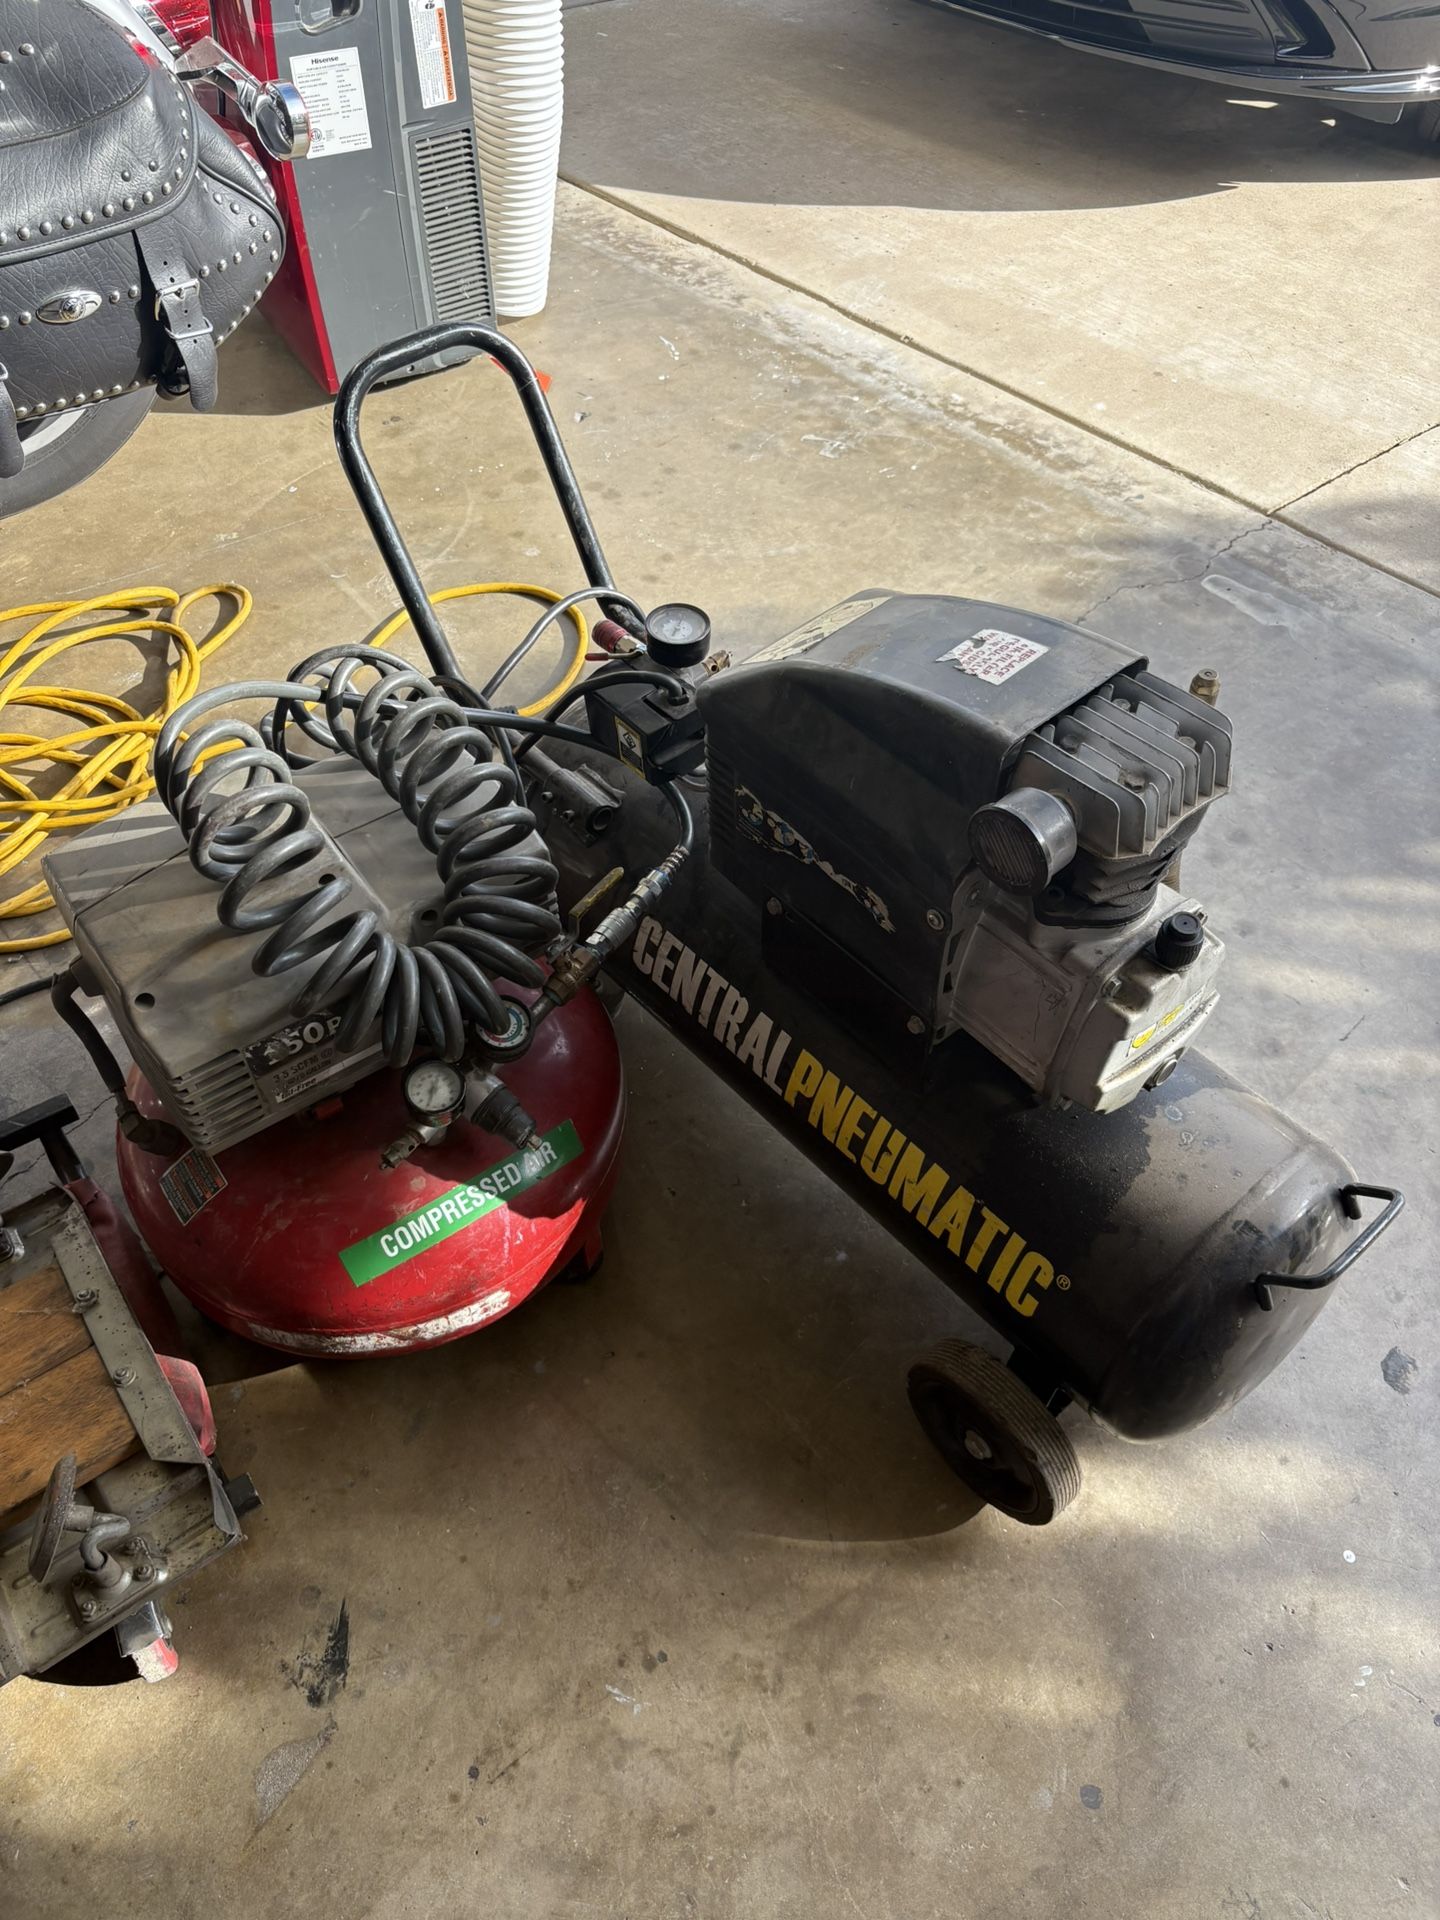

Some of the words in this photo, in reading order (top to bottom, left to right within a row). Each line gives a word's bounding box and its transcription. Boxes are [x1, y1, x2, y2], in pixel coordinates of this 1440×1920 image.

[311, 56, 339, 65] Hisense
[994, 648, 1037, 677] REPLACE
[290, 1056, 320, 1074] SCFM
[632, 916, 792, 1097] CENTRAL
[783, 1048, 1055, 1318] PNEUMATIC
[380, 1162, 522, 1258] COMPRESSED
[522, 1141, 558, 1172] AIR
